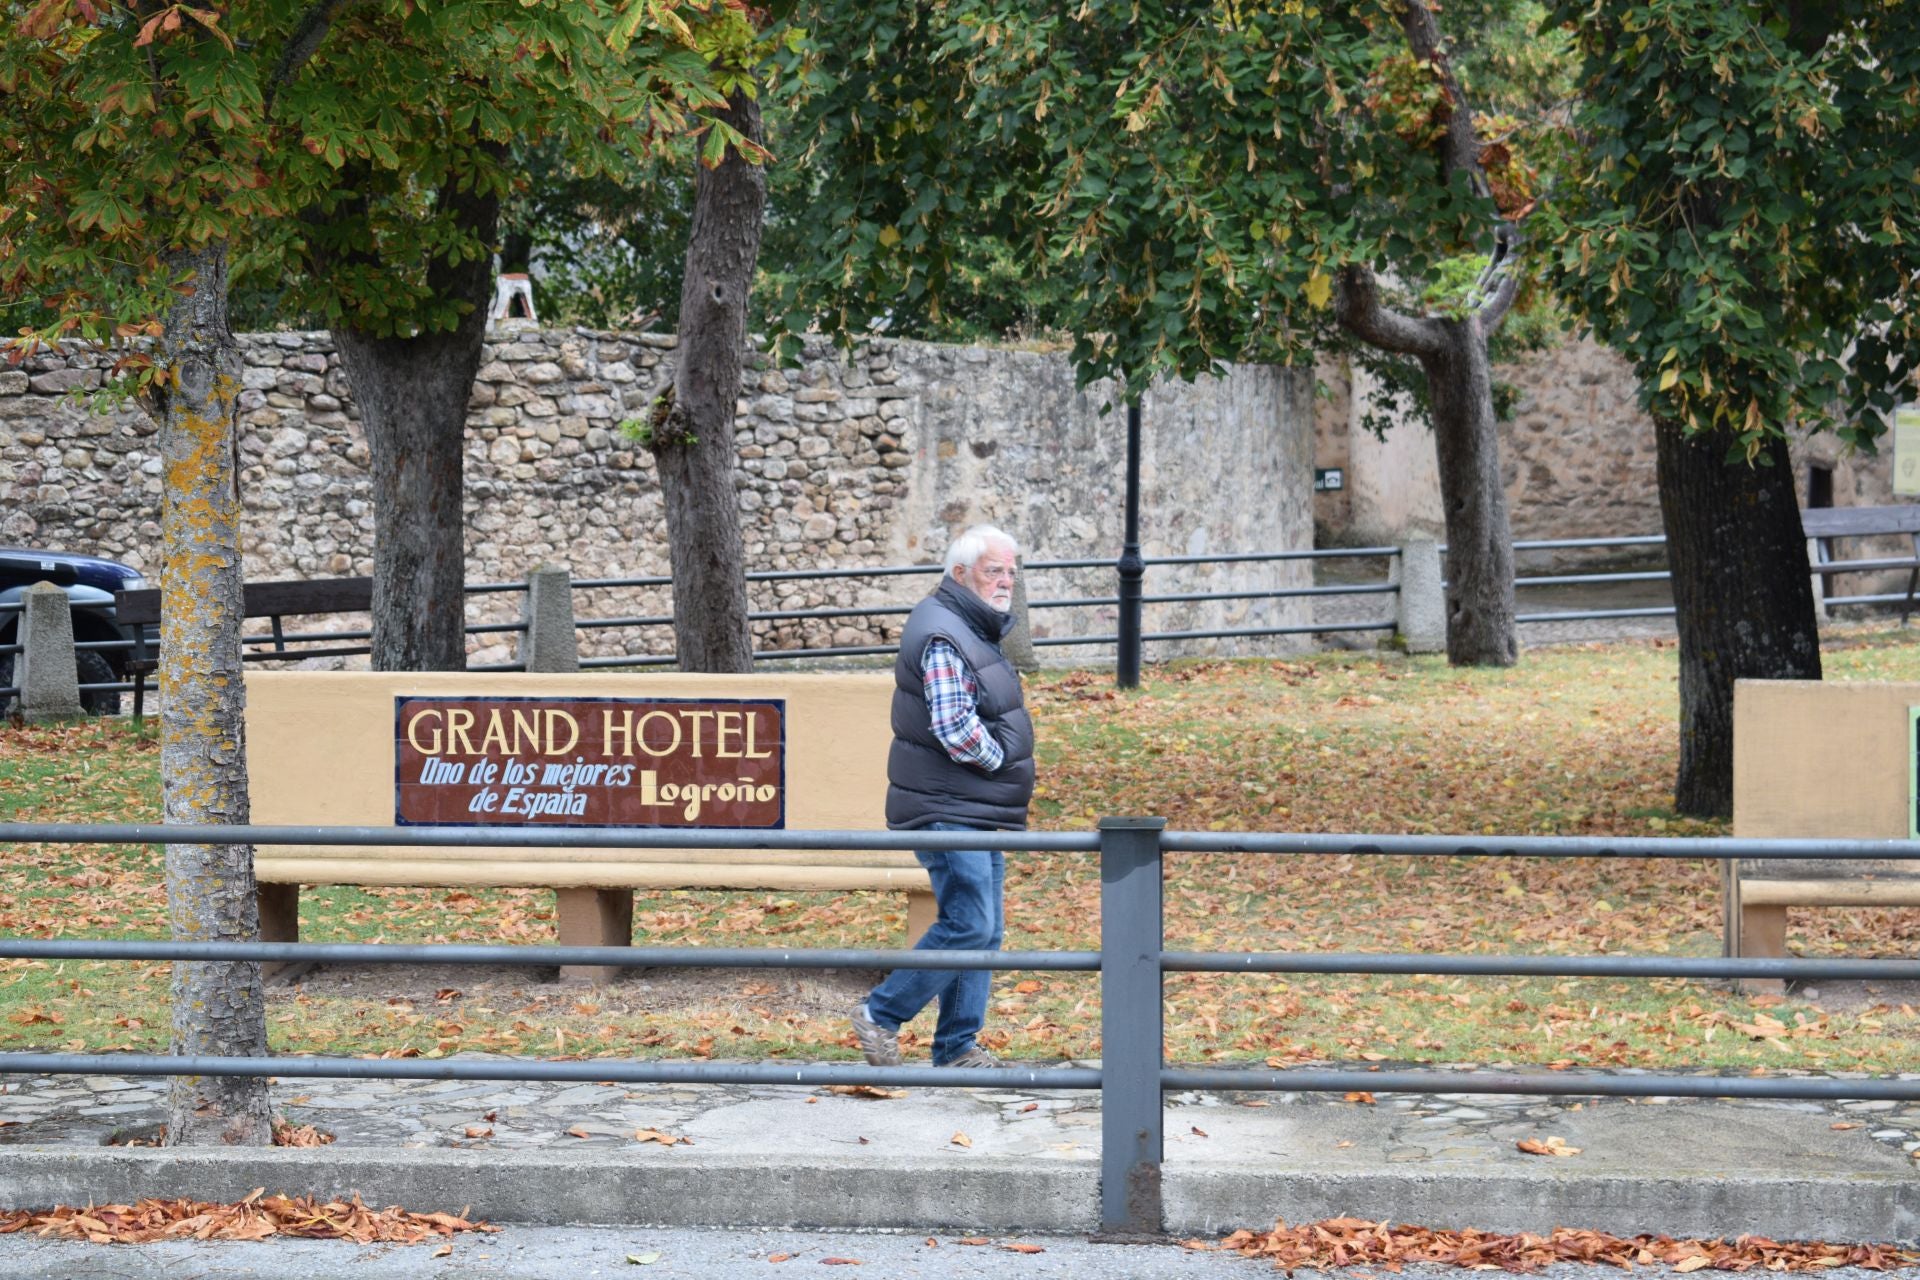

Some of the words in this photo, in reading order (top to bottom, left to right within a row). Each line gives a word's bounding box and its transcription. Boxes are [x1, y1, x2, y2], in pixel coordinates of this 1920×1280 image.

[408, 708, 580, 756] GRAND
[602, 710, 772, 758] HOTEL
[420, 757, 465, 785] Uno
[468, 757, 498, 785] de
[501, 757, 539, 785] los
[541, 756, 636, 791] mejores
[468, 787, 499, 813] de
[500, 787, 588, 819] España
[641, 770, 776, 821] Logroño
